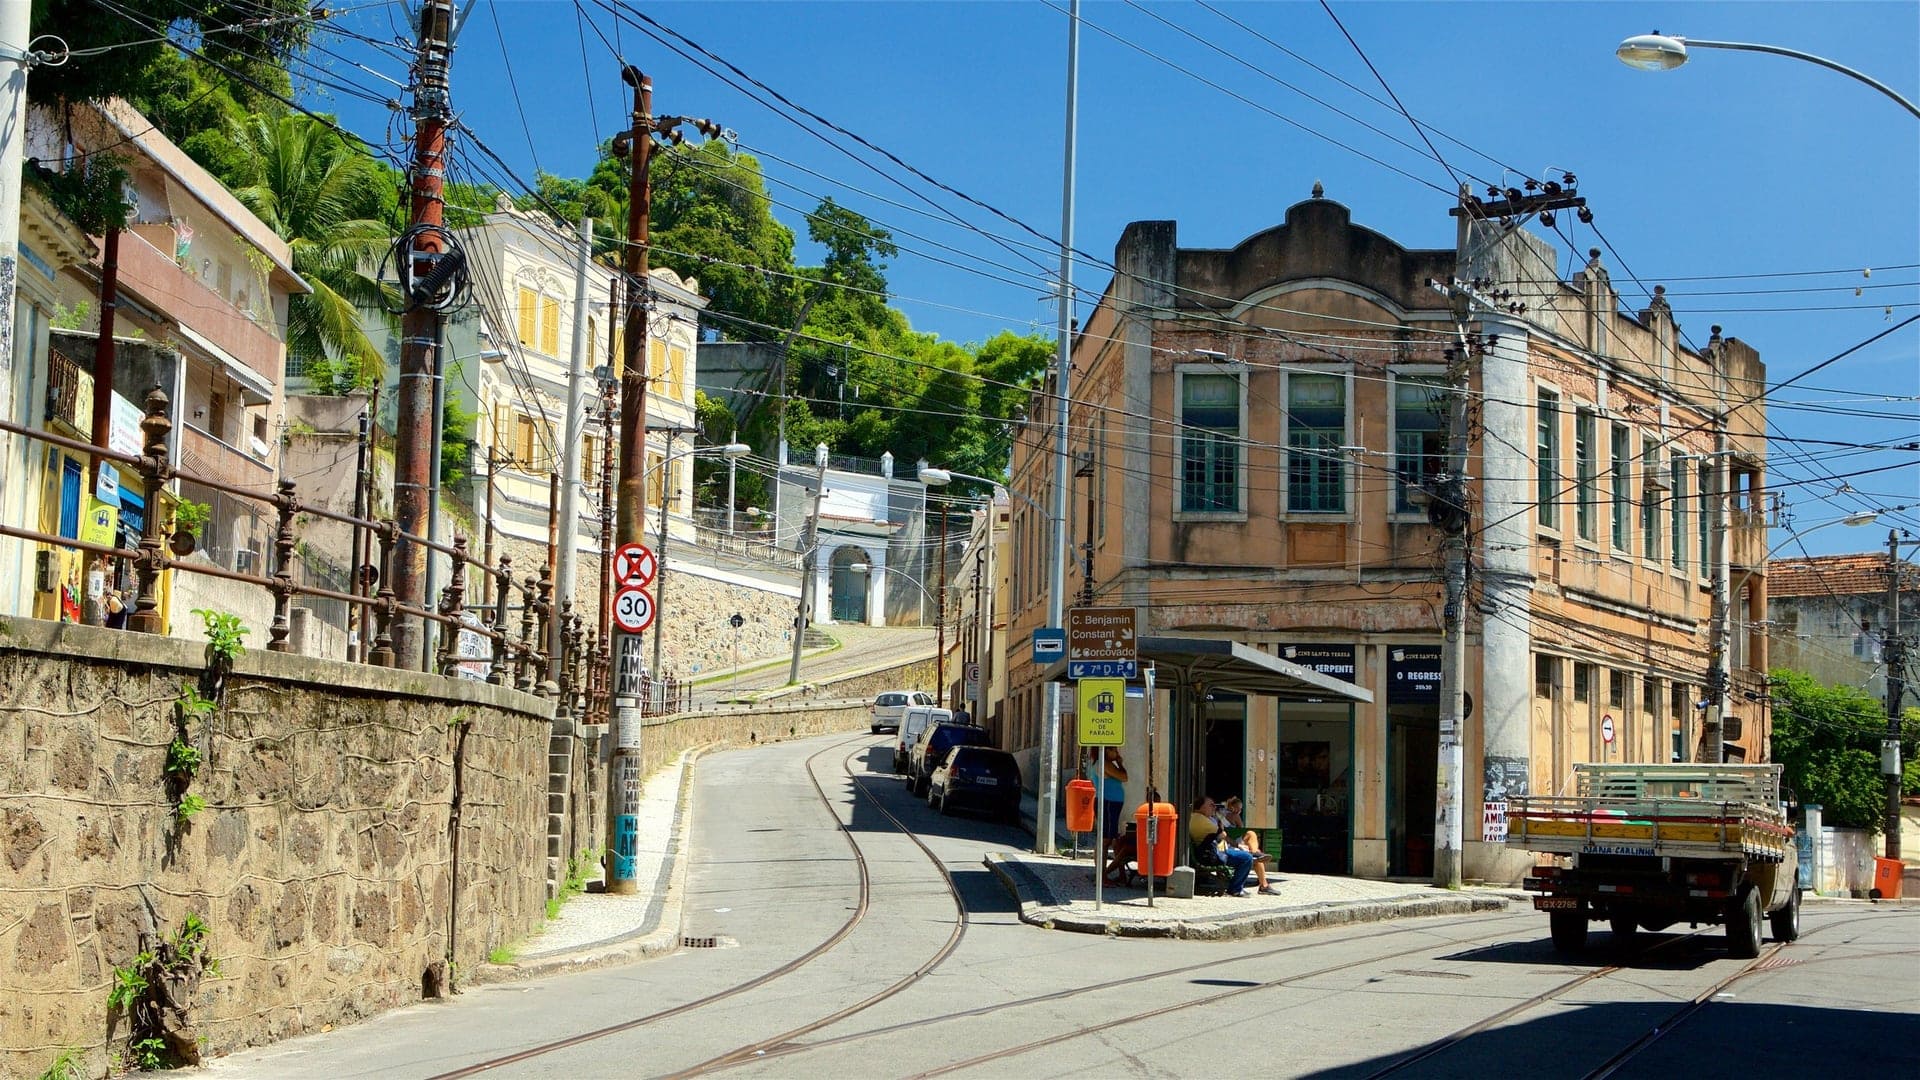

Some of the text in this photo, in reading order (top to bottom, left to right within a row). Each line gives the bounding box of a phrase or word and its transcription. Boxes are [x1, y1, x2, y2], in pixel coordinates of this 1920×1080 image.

[620, 596, 647, 617] 30
[1072, 615, 1130, 626] C. Benjamin
[1072, 630, 1114, 639] Constant
[622, 637, 642, 655] AM
[1083, 648, 1135, 657] Corcovado
[620, 655, 642, 674] AM
[1315, 664, 1354, 674] SERPENTE
[619, 674, 641, 693] AM
